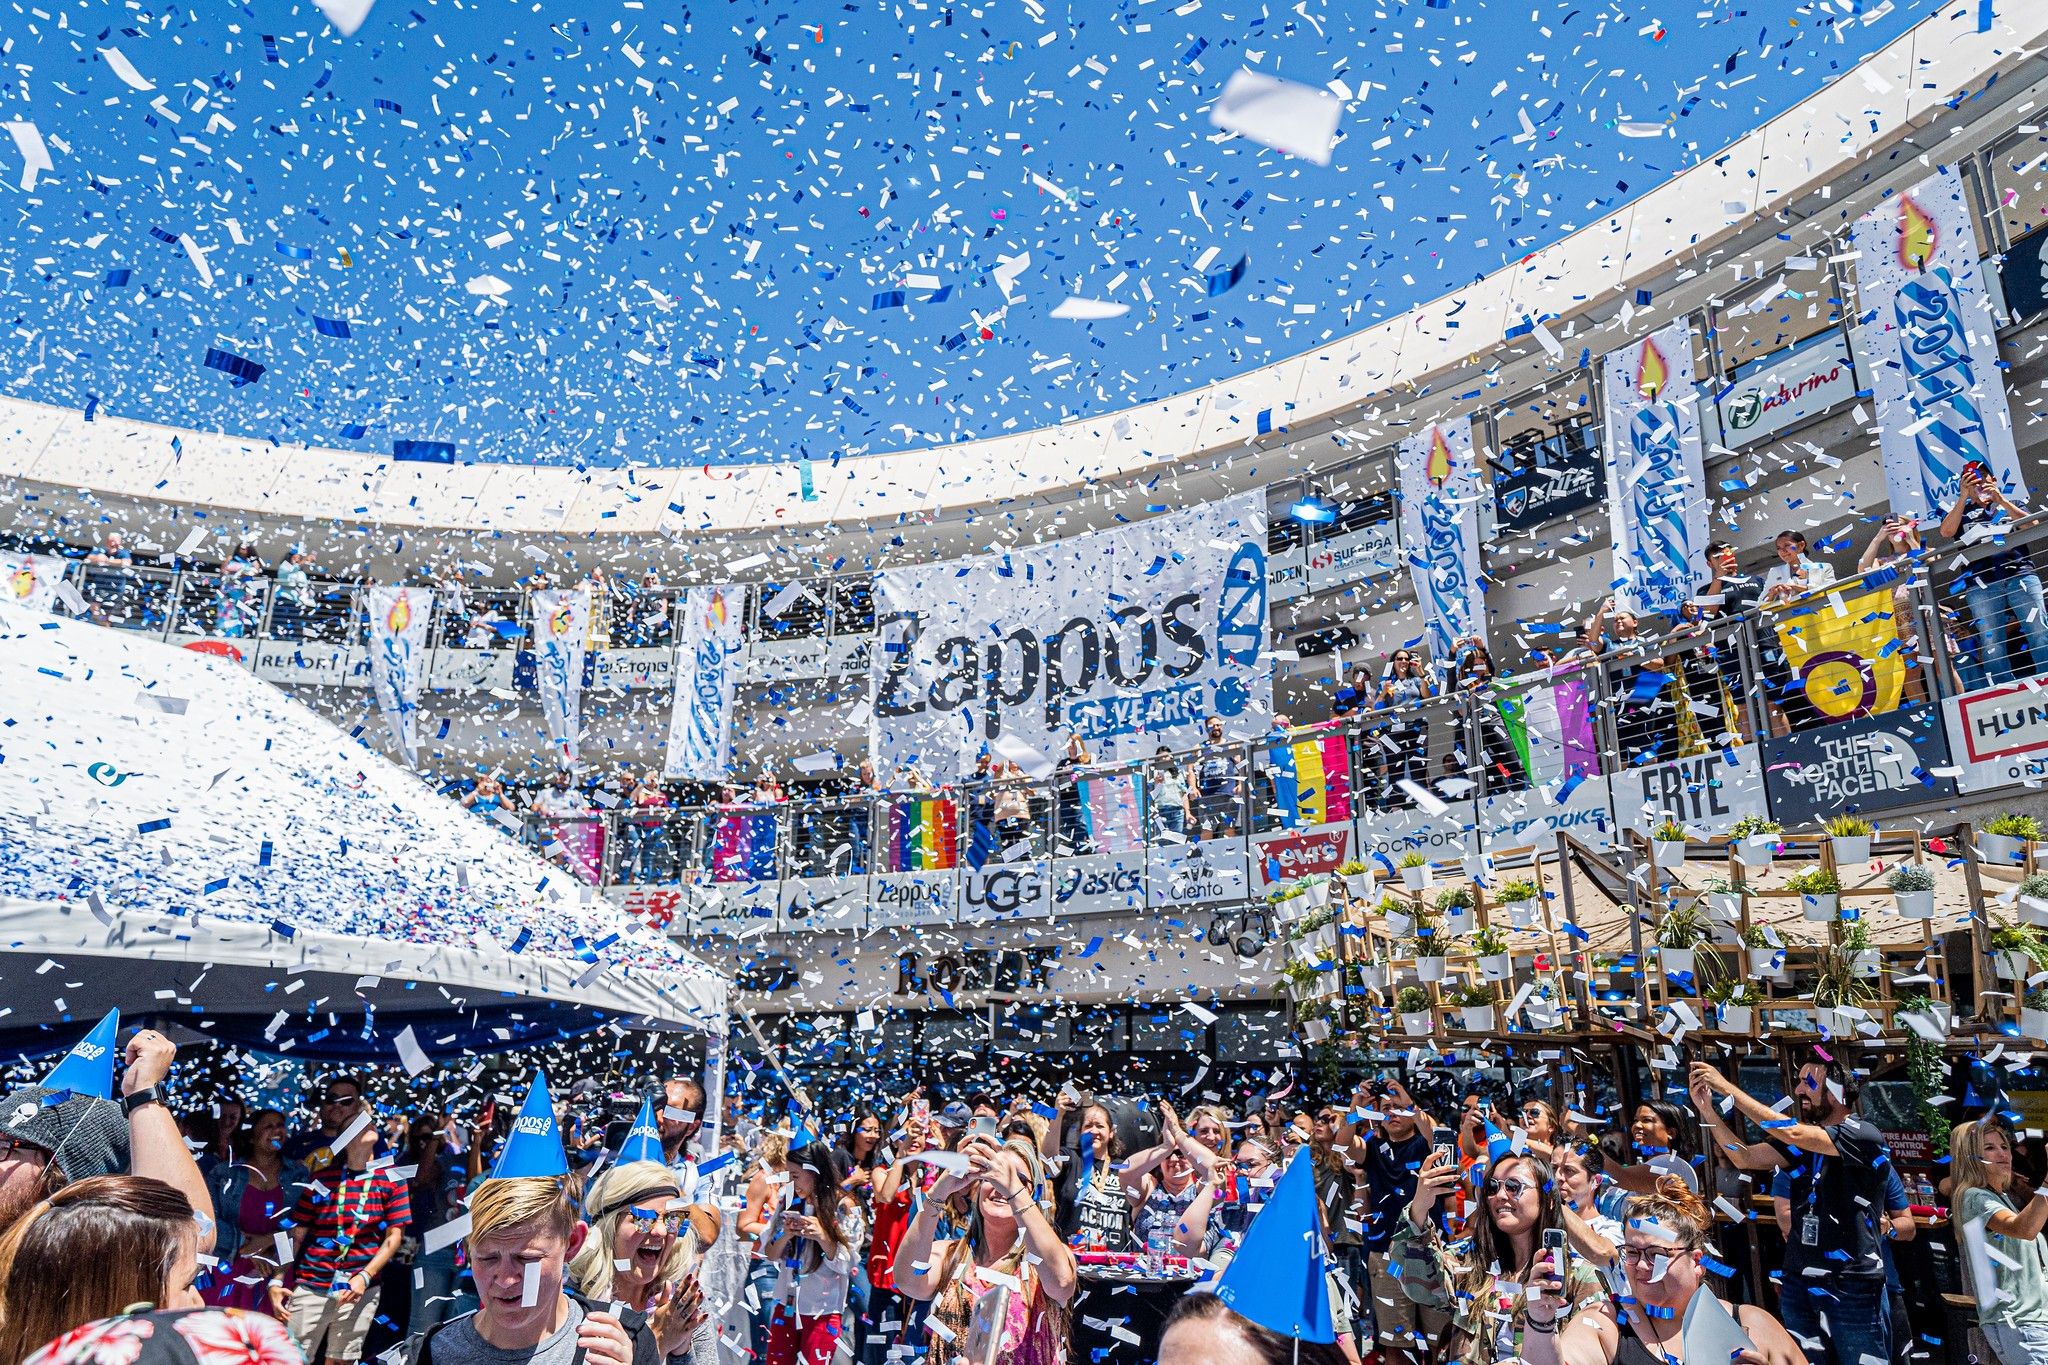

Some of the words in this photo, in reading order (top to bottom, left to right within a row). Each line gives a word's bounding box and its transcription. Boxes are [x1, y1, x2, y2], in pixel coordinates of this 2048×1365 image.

[1907, 294, 1964, 407] 2011
[874, 593, 1206, 740] Zappos
[1113, 690, 1199, 729] YEARS
[1820, 733, 1870, 762] THE
[1640, 755, 1730, 828] FRYE
[1815, 772, 1876, 802] FACE
[1513, 808, 1607, 837] BOOKS
[966, 870, 1042, 913] UGG
[1888, 1141, 1926, 1150] CONTROL
[1895, 1150, 1922, 1158] PANEL
[1080, 1206, 1123, 1230] ACTION
